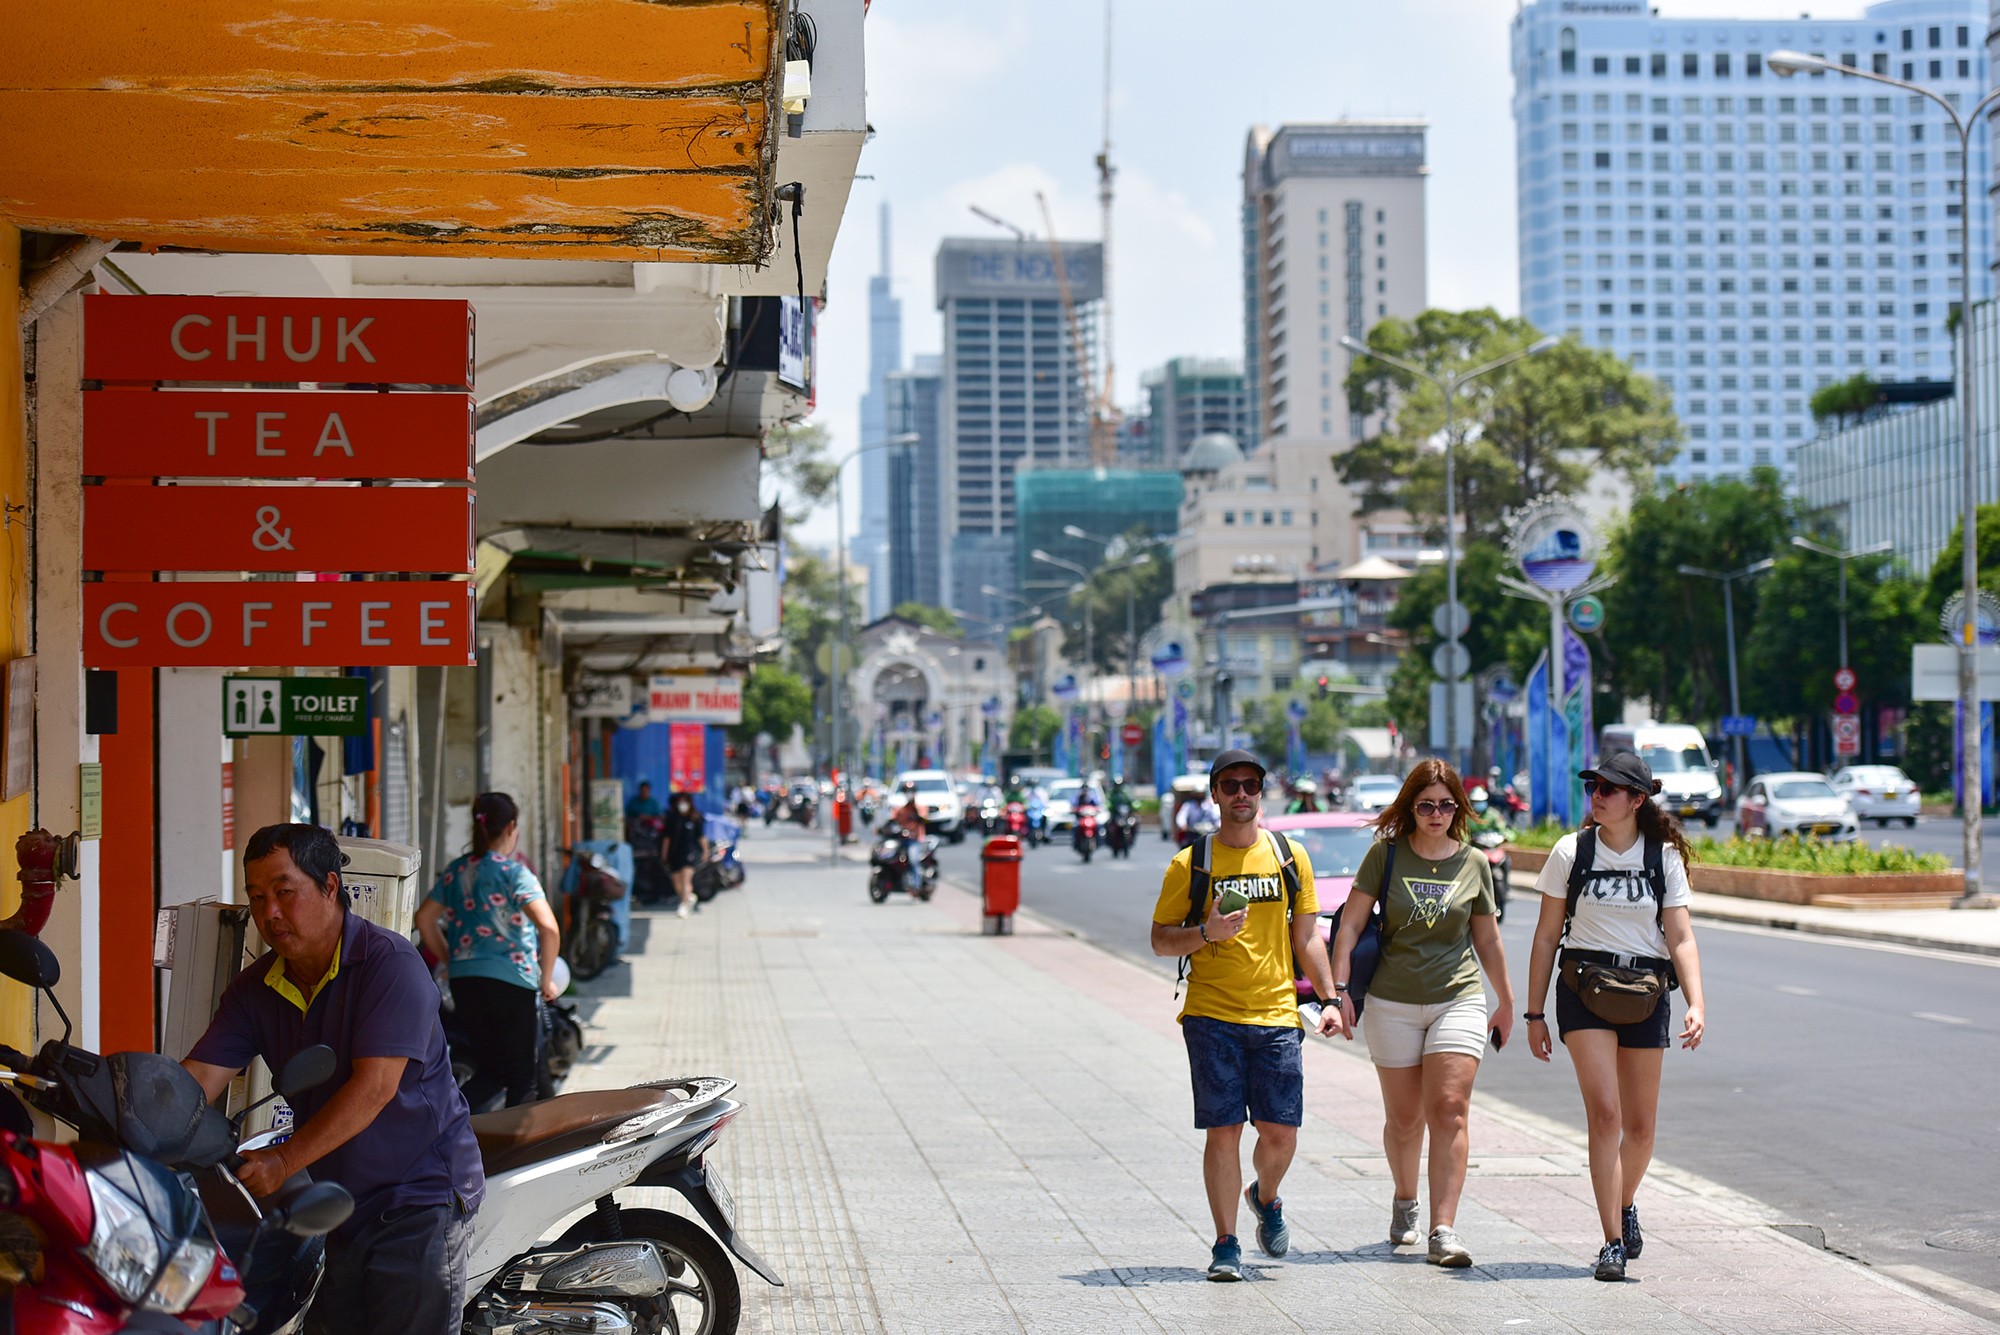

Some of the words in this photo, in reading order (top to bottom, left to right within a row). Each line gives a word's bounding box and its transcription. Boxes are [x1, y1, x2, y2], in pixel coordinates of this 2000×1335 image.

[170, 314, 377, 364] CHUK
[194, 412, 355, 457] TEA
[251, 505, 296, 551] &
[98, 600, 452, 649] COFFEE
[291, 695, 358, 713] TOILET
[295, 714, 313, 722] FREE
[313, 714, 323, 722] OF
[324, 714, 354, 722] CHARGE
[1412, 882, 1449, 895] GUESS
